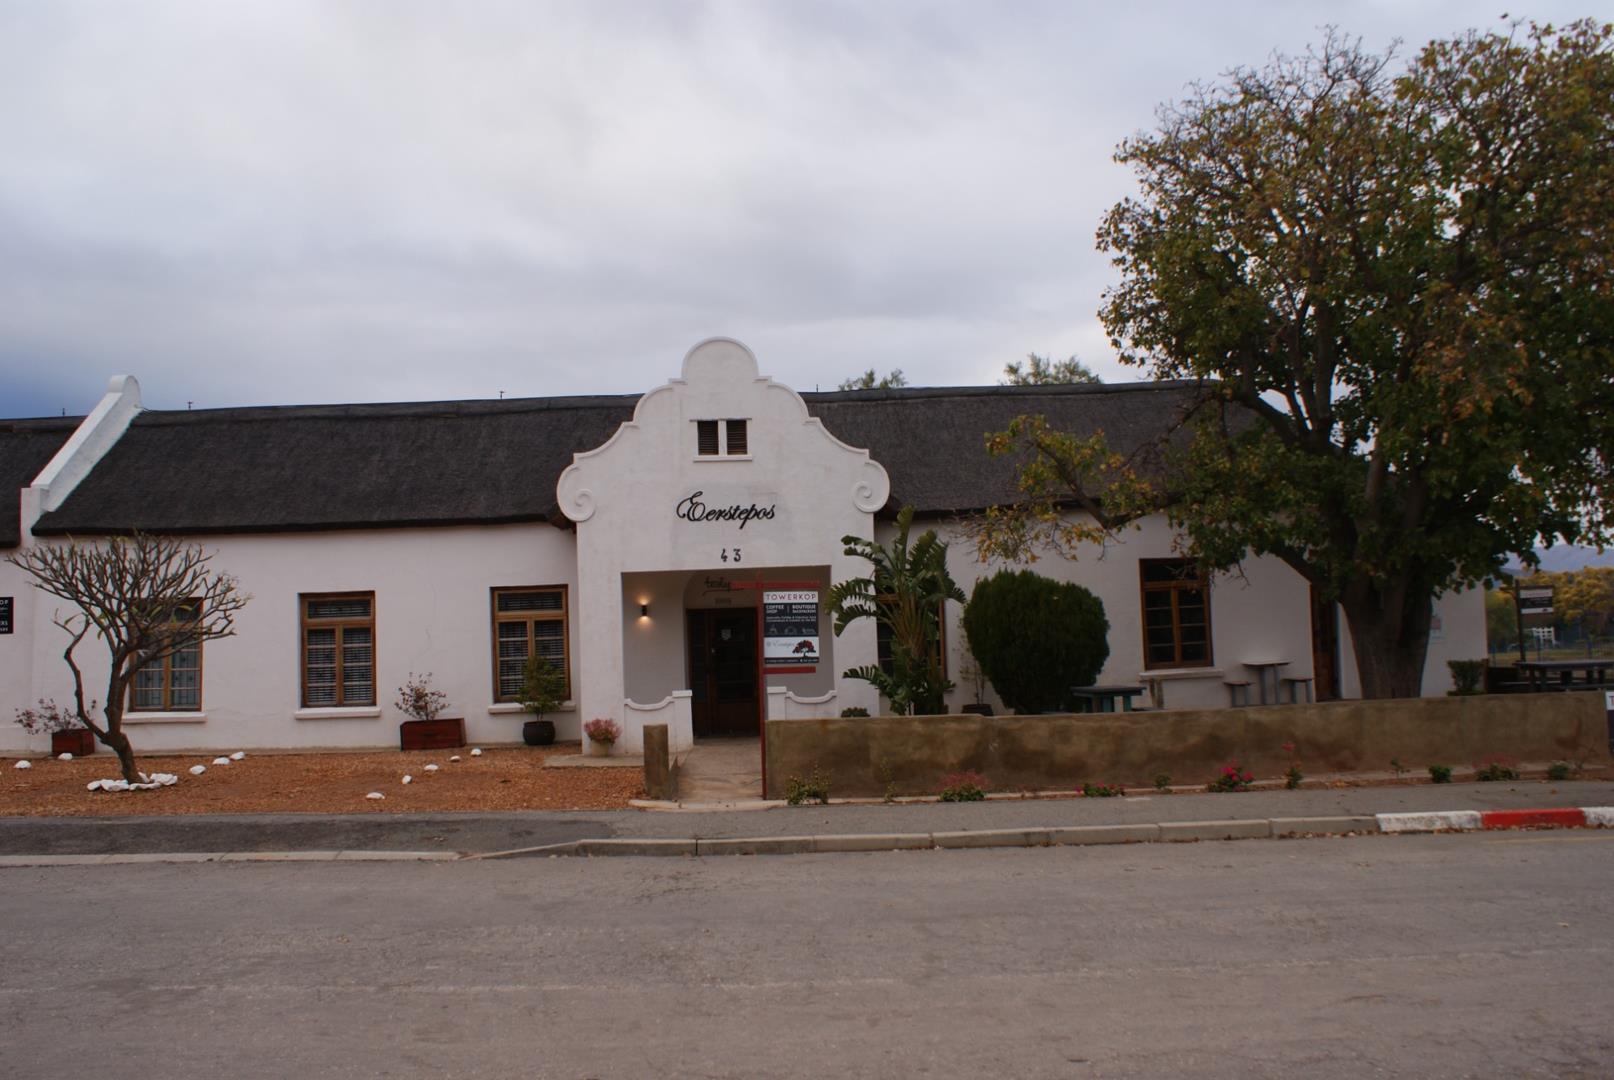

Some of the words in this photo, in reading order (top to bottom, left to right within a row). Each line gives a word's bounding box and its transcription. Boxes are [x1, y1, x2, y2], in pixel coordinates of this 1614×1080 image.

[676, 490, 776, 530] Eerstepos
[720, 548, 742, 562] 43
[766, 593, 816, 601] TOWERKOP
